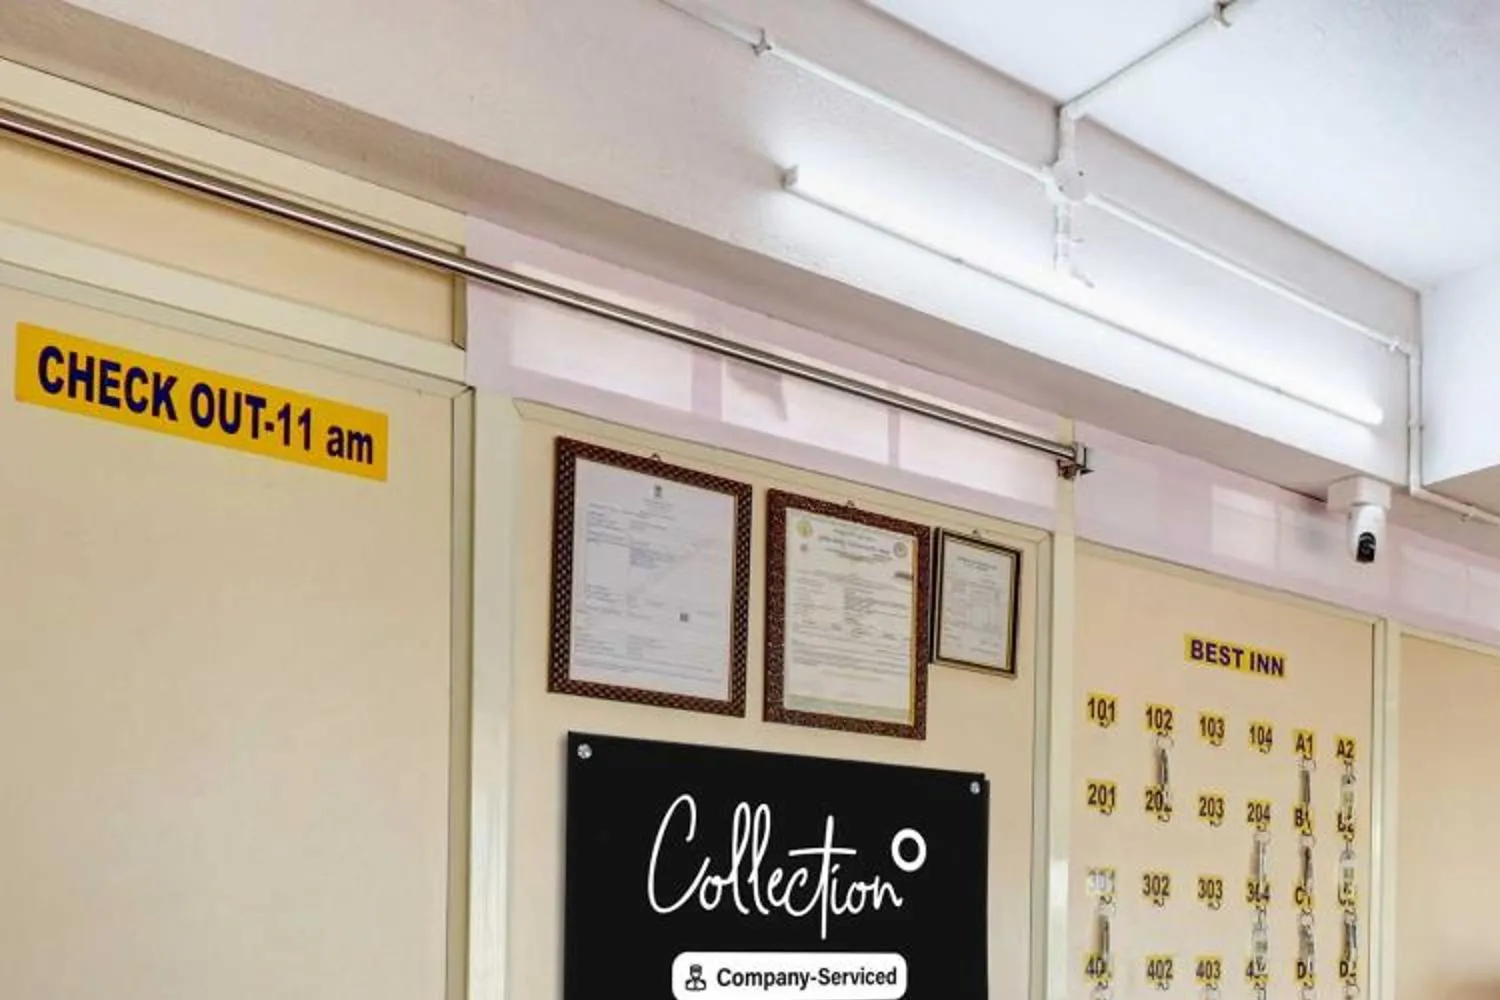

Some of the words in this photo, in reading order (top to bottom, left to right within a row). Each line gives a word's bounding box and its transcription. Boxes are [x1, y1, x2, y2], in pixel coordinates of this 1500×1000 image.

[38, 345, 178, 422] CHECK
[190, 382, 312, 451] OUT-11
[326, 425, 374, 465] am
[1190, 639, 1244, 670] BEST
[1250, 652, 1285, 677] INN
[1088, 698, 1116, 723] 101
[1145, 706, 1173, 731] 102
[1200, 716, 1225, 739] 103
[1250, 725, 1273, 746] 104
[1295, 732, 1313, 756] A1
[1336, 739, 1355, 759] A2
[1088, 784, 1116, 806] 201
[1199, 797, 1225, 819] 203
[1247, 803, 1271, 823] 204
[647, 793, 904, 940] Collection
[1143, 874, 1170, 896] 302
[1198, 878, 1223, 900] 303
[716, 966, 898, 991] Company-Serviced
[1147, 959, 1173, 981] 402
[1196, 960, 1221, 980] 403
